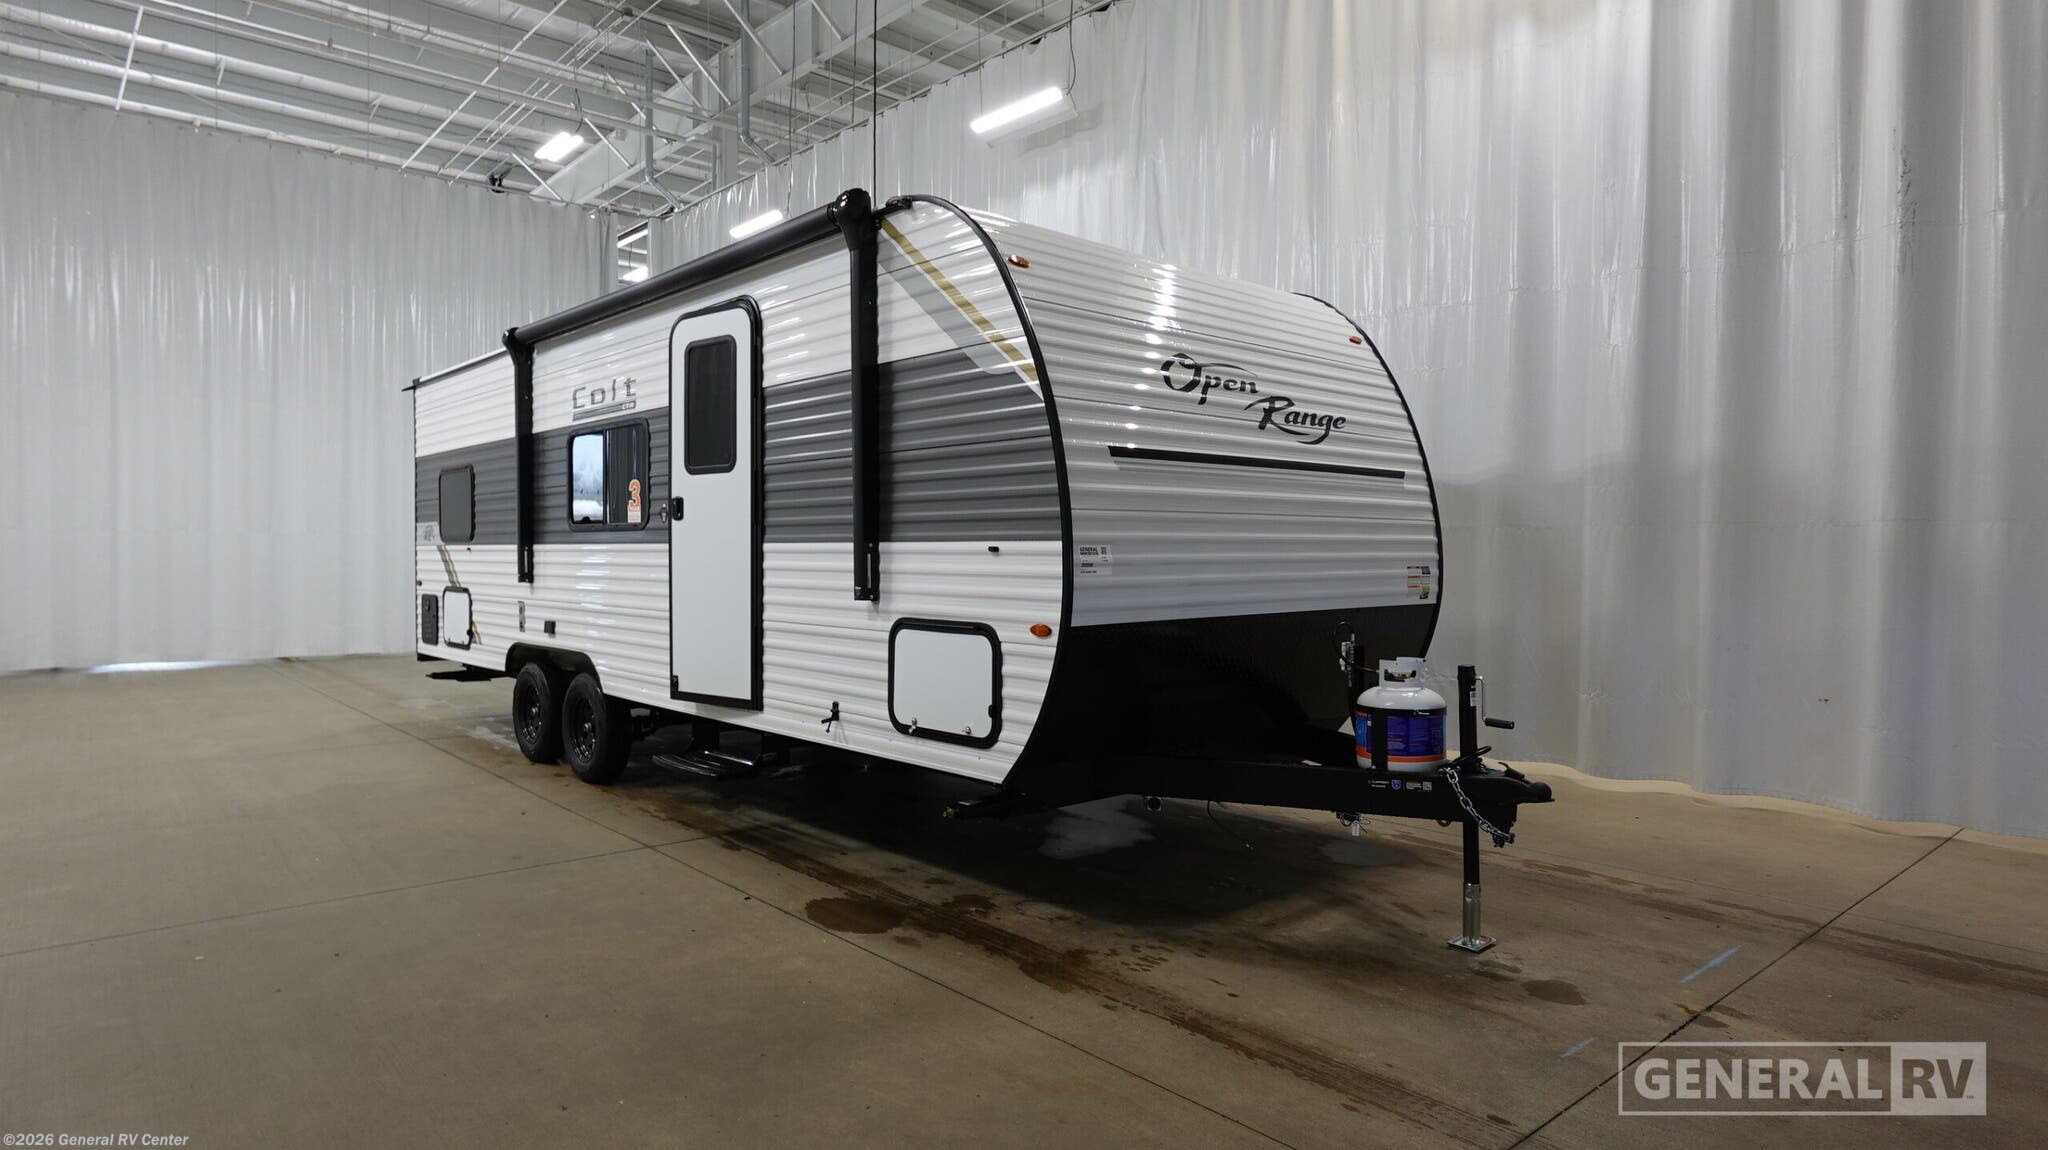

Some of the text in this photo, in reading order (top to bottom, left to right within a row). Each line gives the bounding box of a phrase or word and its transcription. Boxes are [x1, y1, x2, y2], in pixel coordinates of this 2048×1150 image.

[573, 378, 636, 409] Colt
[1161, 353, 1259, 405] Open
[1244, 396, 1347, 444] Range
[628, 479, 640, 508] 3
